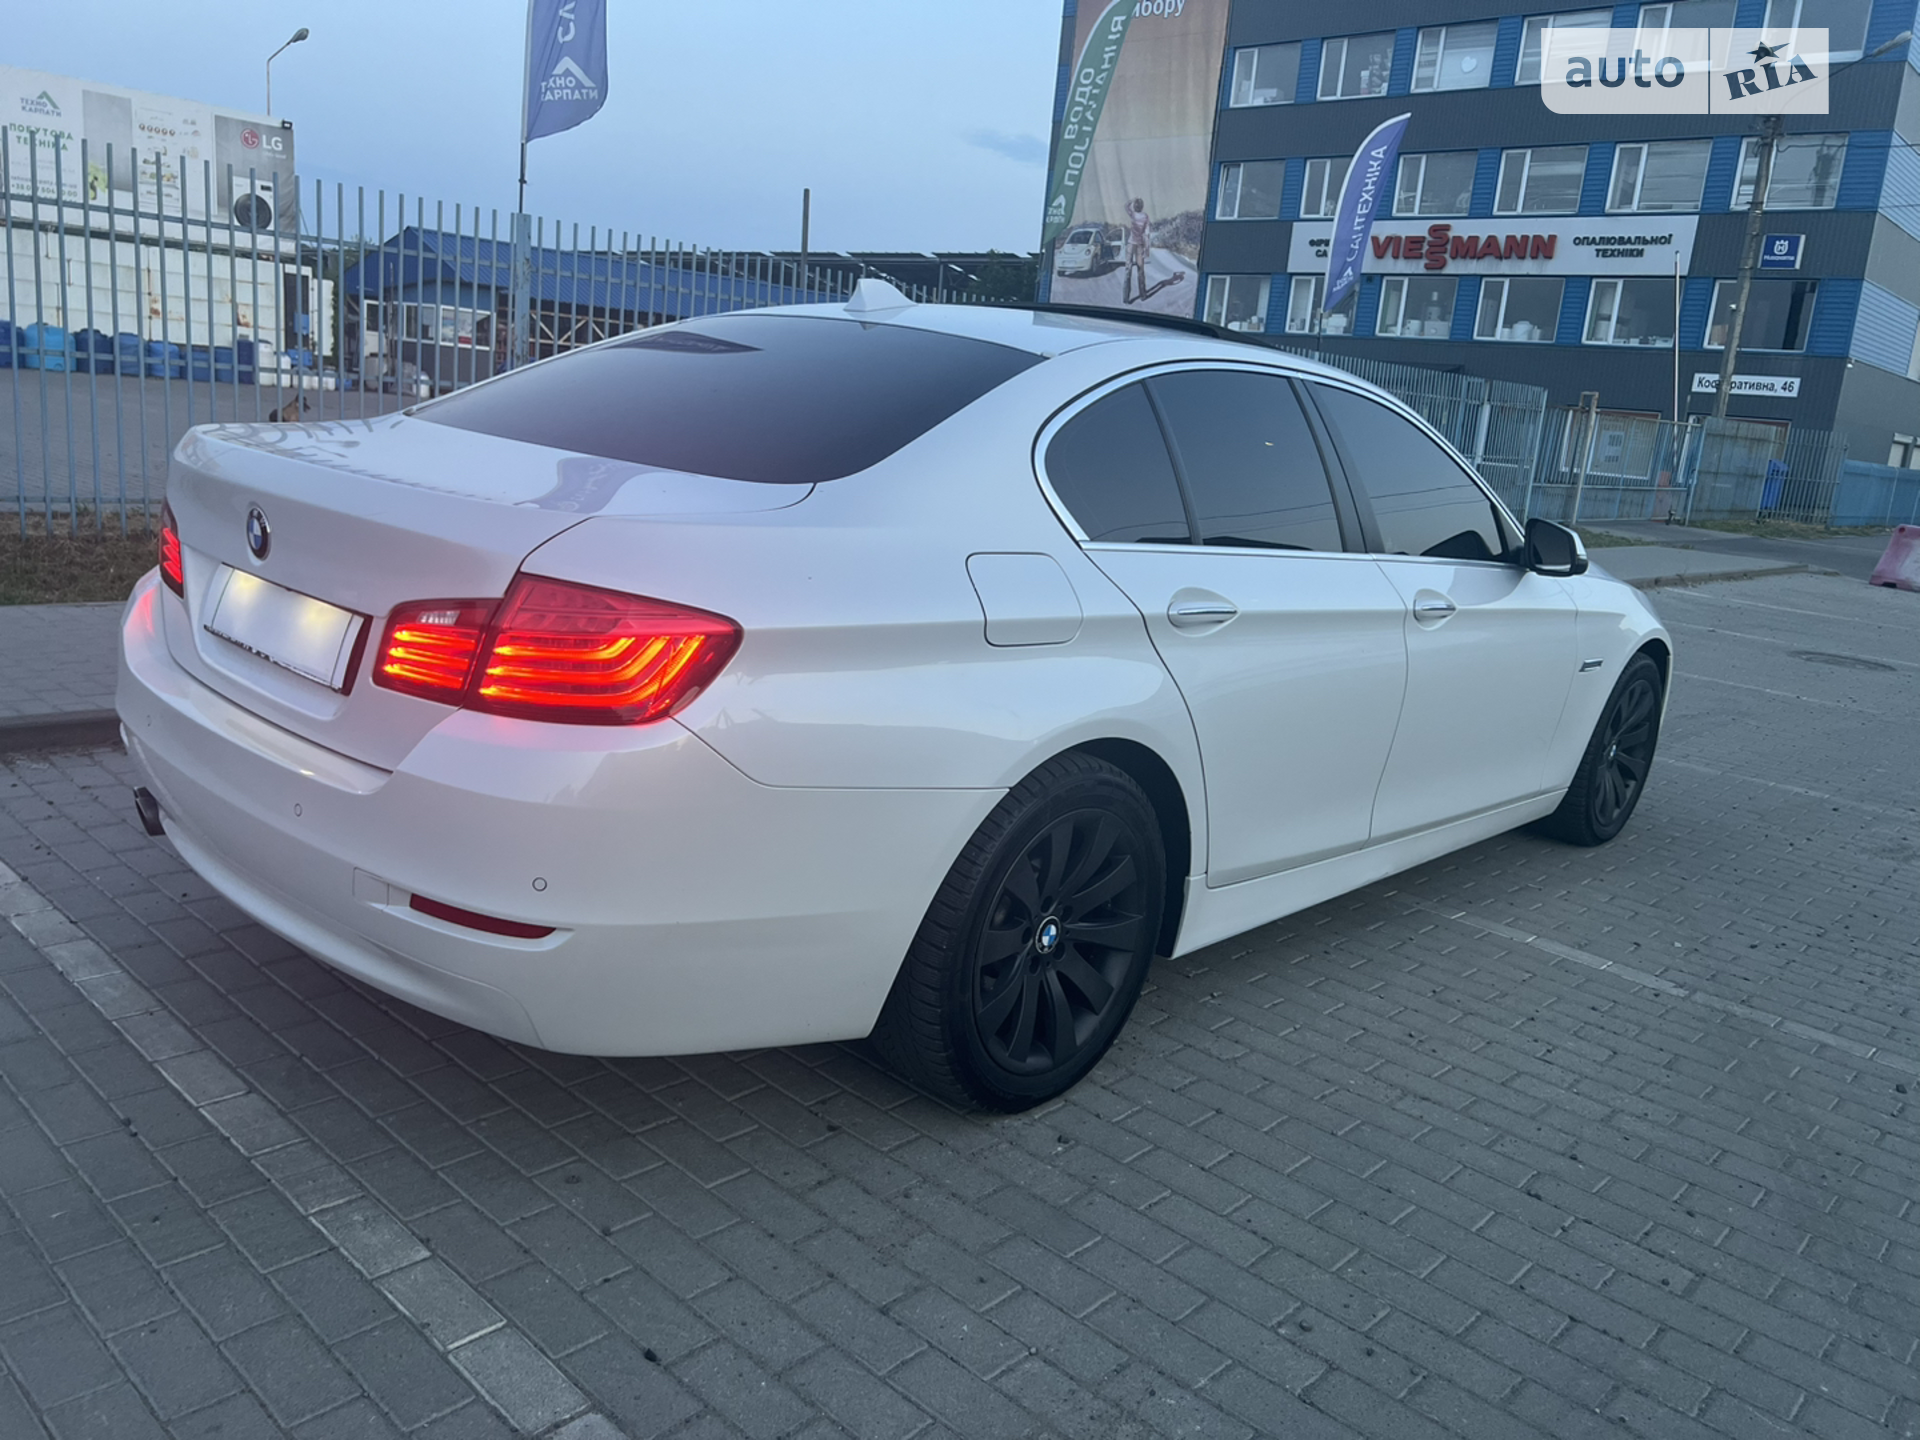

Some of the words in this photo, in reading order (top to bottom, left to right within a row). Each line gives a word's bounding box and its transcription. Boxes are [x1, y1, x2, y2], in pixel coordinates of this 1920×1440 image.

[541, 76, 576, 92] ТХНО
[20, 97, 48, 109] ТЕХНО
[1063, 68, 1095, 140] ВОДО
[21, 105, 62, 118] КАРПАТИ
[16, 135, 69, 151] ТЕНІА
[262, 134, 283, 151] LG
[1573, 233, 1674, 246] ОПАЛЮВАЛЬНОЇ
[1371, 224, 1558, 270] VIESSMANN
[1594, 247, 1645, 258] ТЕХНІКИ
[1780, 380, 1796, 393] 46
